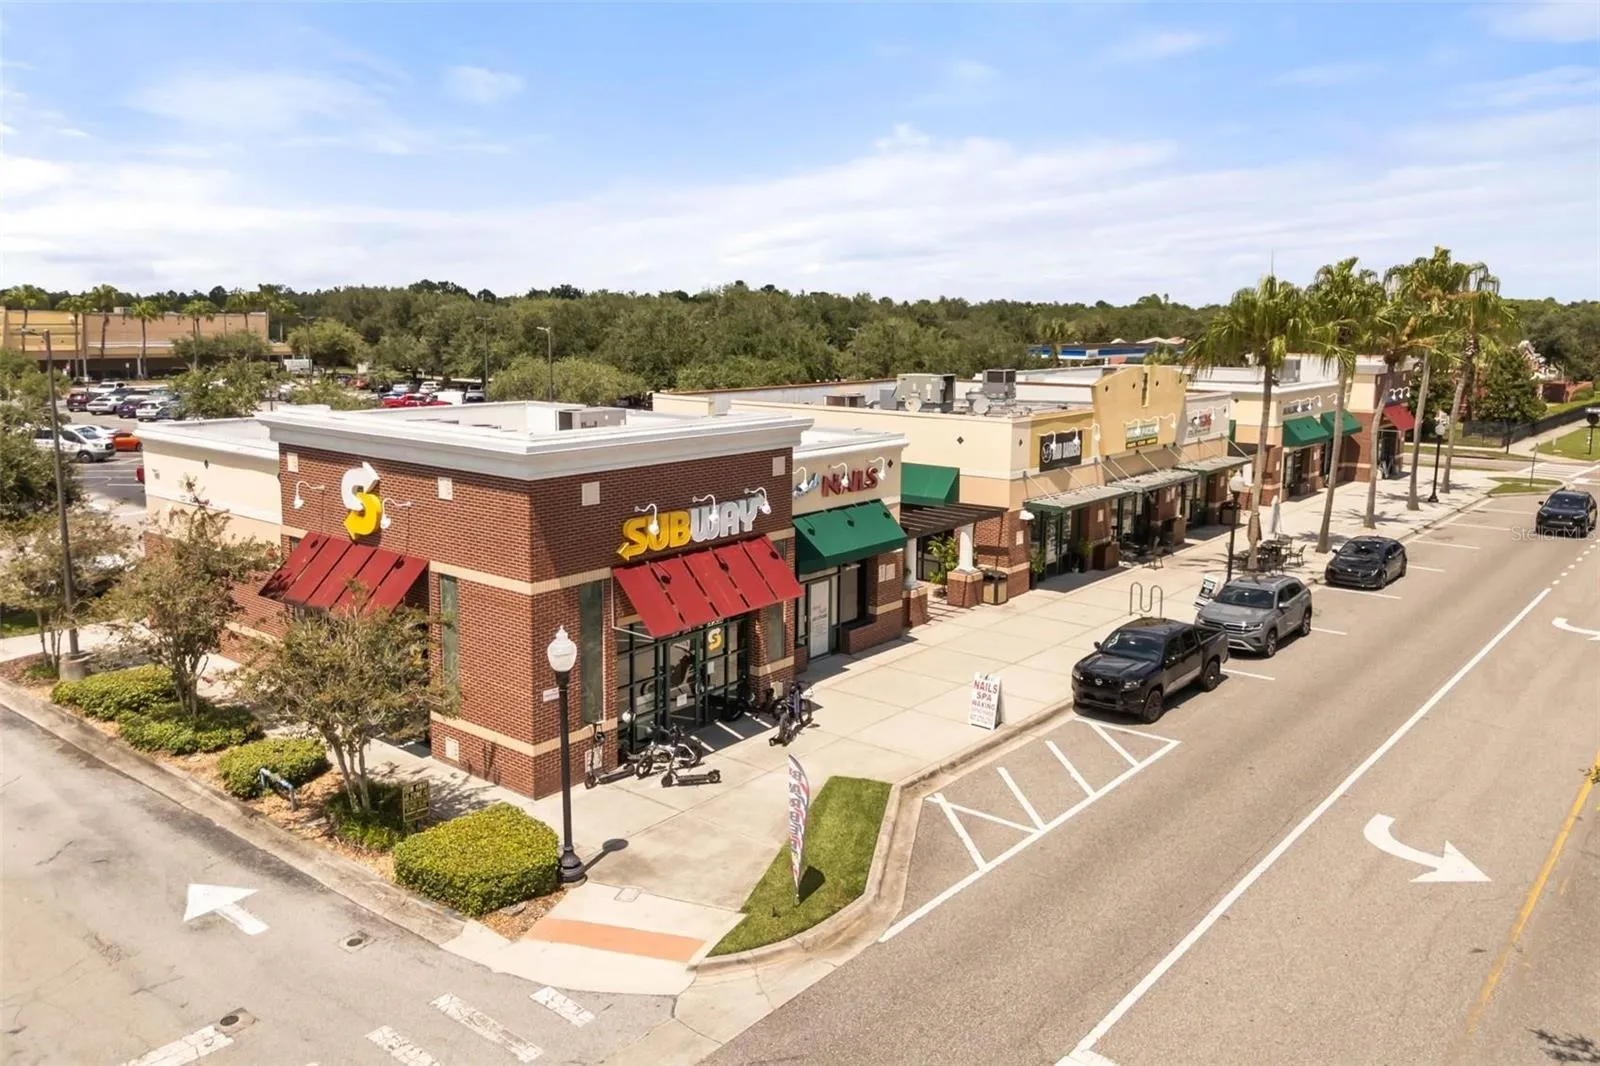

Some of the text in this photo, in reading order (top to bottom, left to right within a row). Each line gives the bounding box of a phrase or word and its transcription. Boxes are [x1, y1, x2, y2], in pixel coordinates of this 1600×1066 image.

[616, 493, 766, 561] SUBWAY
[974, 680, 998, 694] NAILS
[976, 691, 992, 702] SPA
